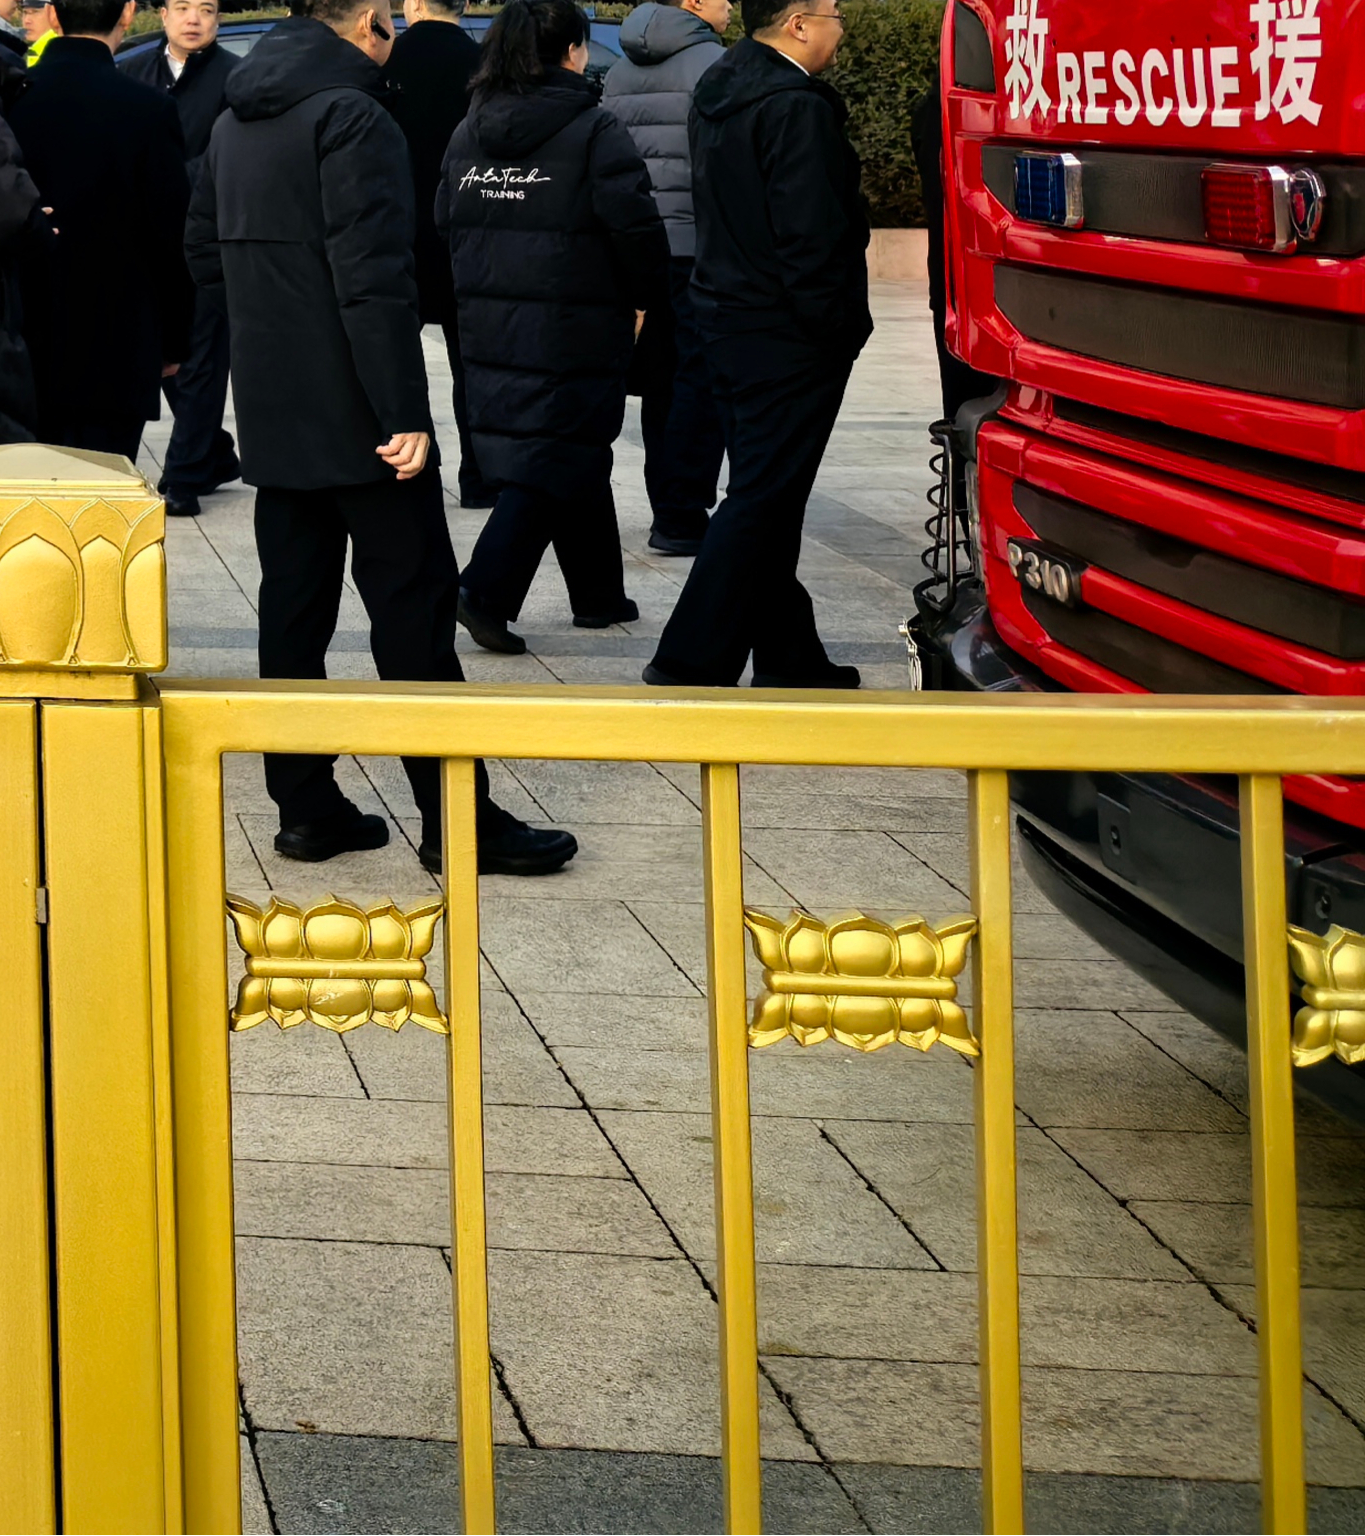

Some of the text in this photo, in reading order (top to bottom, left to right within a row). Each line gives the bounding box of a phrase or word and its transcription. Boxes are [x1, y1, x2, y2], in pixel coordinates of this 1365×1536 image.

[1056, 46, 1242, 127] RESCUE
[481, 189, 526, 200] TRAINING
[1008, 543, 1069, 602] P 310
